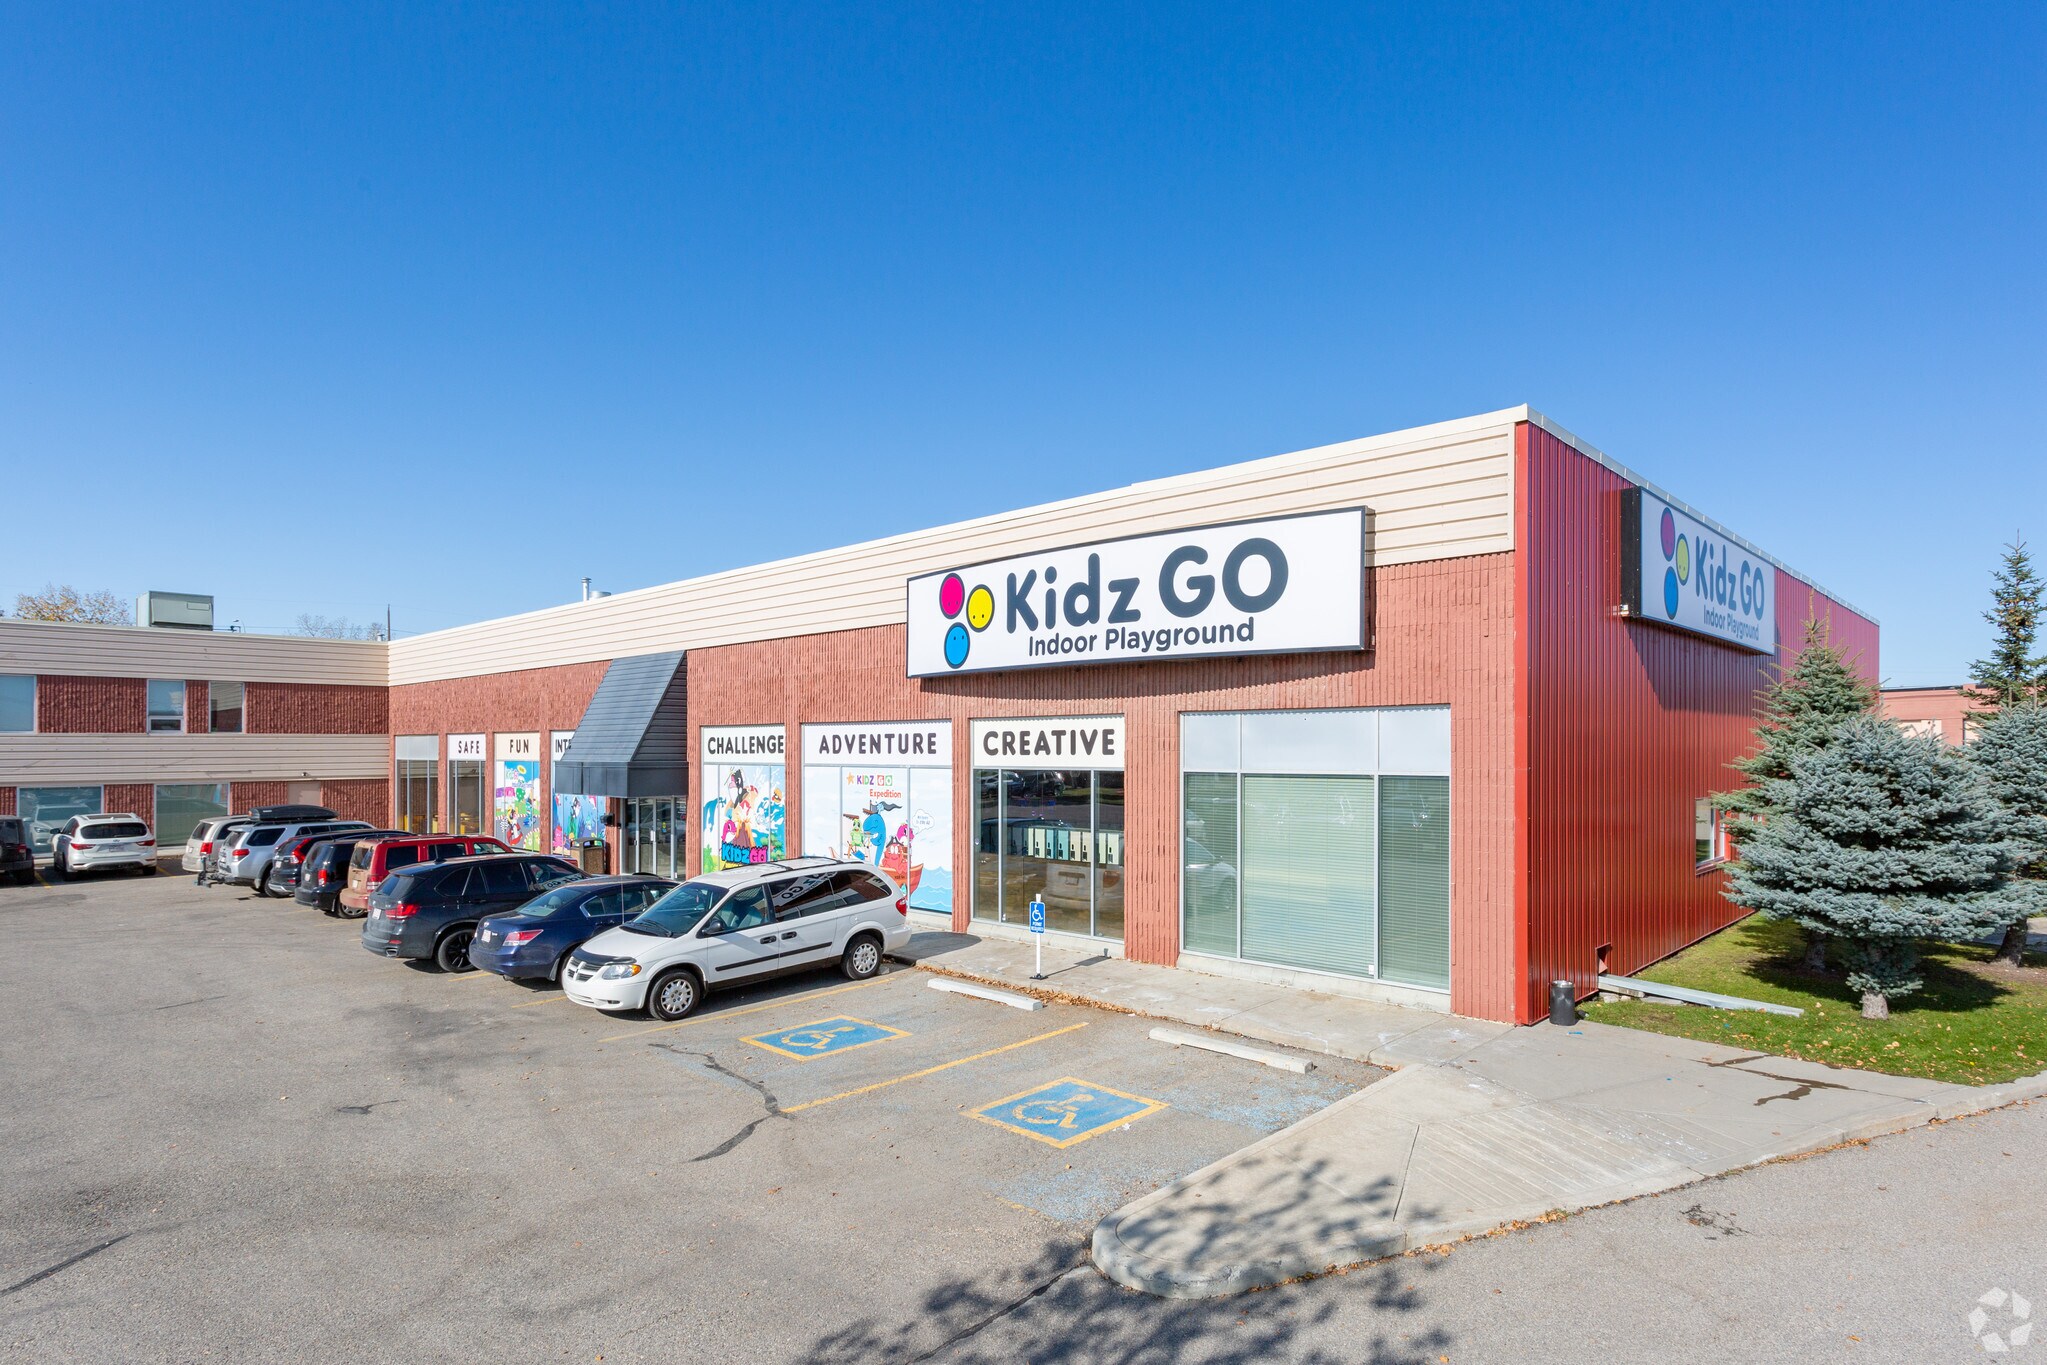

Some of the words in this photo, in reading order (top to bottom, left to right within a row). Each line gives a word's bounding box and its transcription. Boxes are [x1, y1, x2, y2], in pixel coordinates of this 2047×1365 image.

[1006, 552, 1141, 634] Kidz
[1158, 537, 1289, 618] GO
[1695, 535, 1737, 612] Kidz
[1740, 560, 1765, 621] GO
[1703, 604, 1726, 628] Indoor
[1727, 614, 1759, 641] Playground
[1028, 631, 1097, 657] Indoor
[1105, 616, 1254, 653] Playground
[458, 740, 480, 754] SAFE
[509, 739, 529, 753] FUN
[707, 735, 784, 755] CHALLENGE
[819, 732, 937, 755] ADVENTURE
[982, 728, 1115, 756] CREATIVE
[856, 774, 875, 786] KIDZ
[877, 774, 893, 786] GO
[869, 788, 902, 799] Expedition
